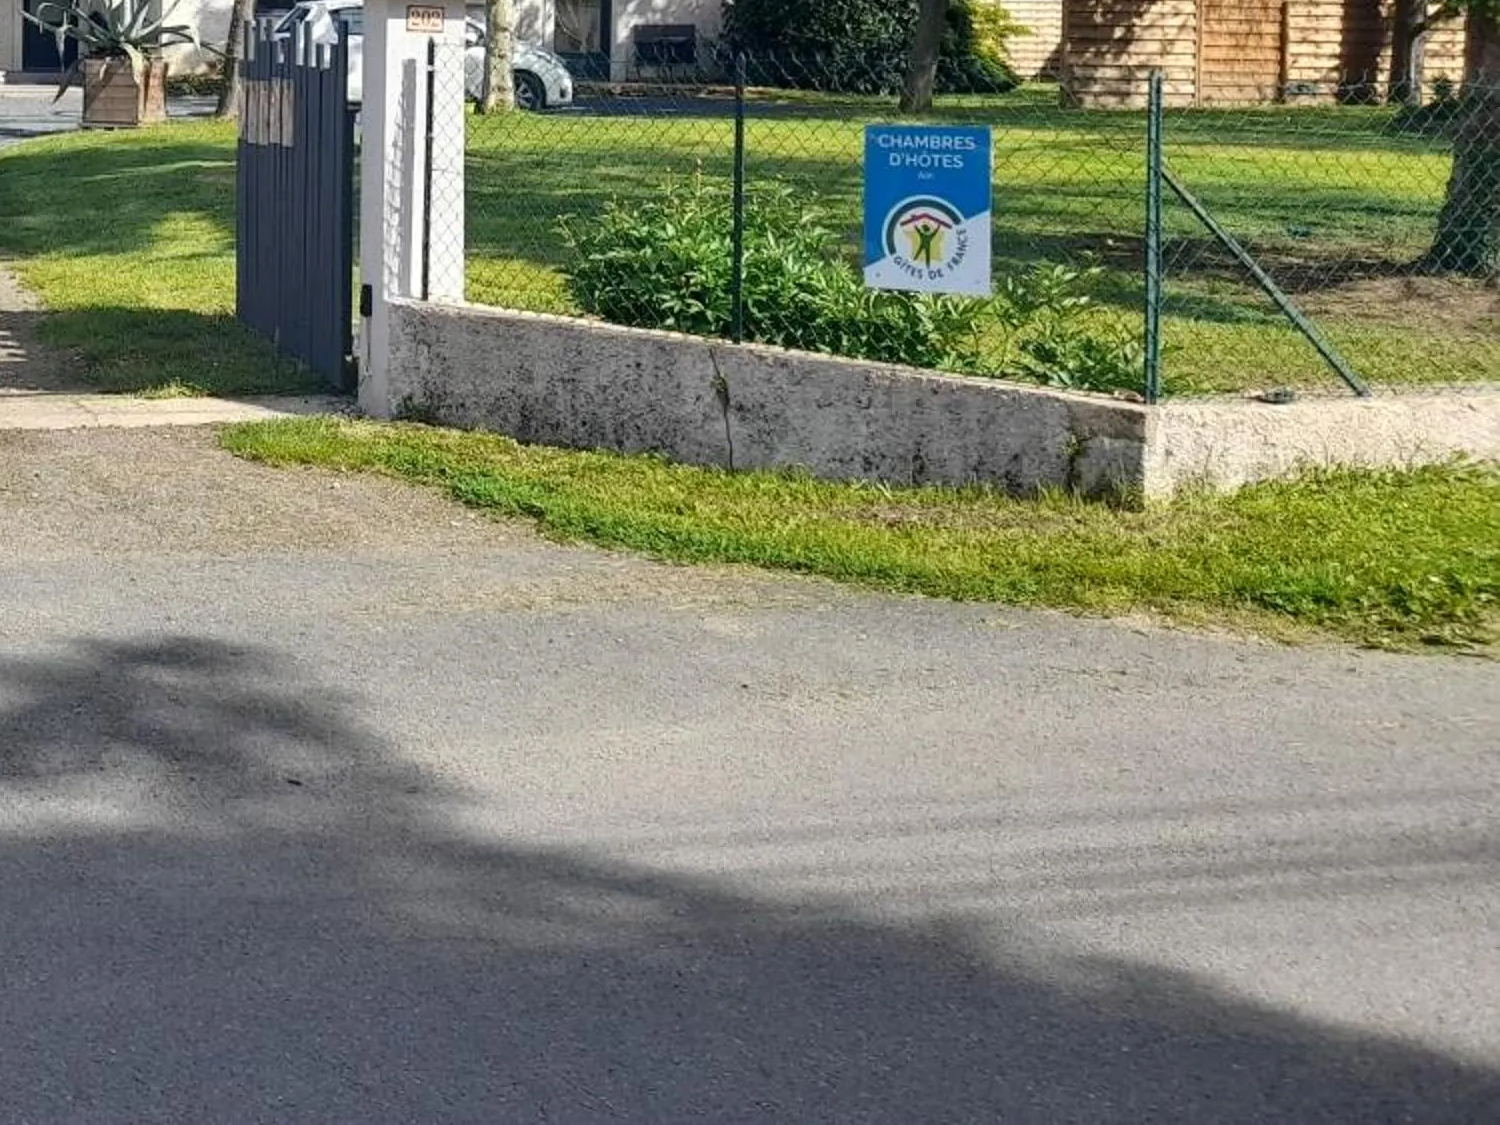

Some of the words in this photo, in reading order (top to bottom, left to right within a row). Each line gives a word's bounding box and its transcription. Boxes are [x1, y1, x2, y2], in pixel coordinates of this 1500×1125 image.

[879, 134, 976, 150] CHAMBRES
[889, 150, 965, 169] D'HÔTES
[928, 268, 944, 280] DE
[946, 228, 969, 272] FRANCE
